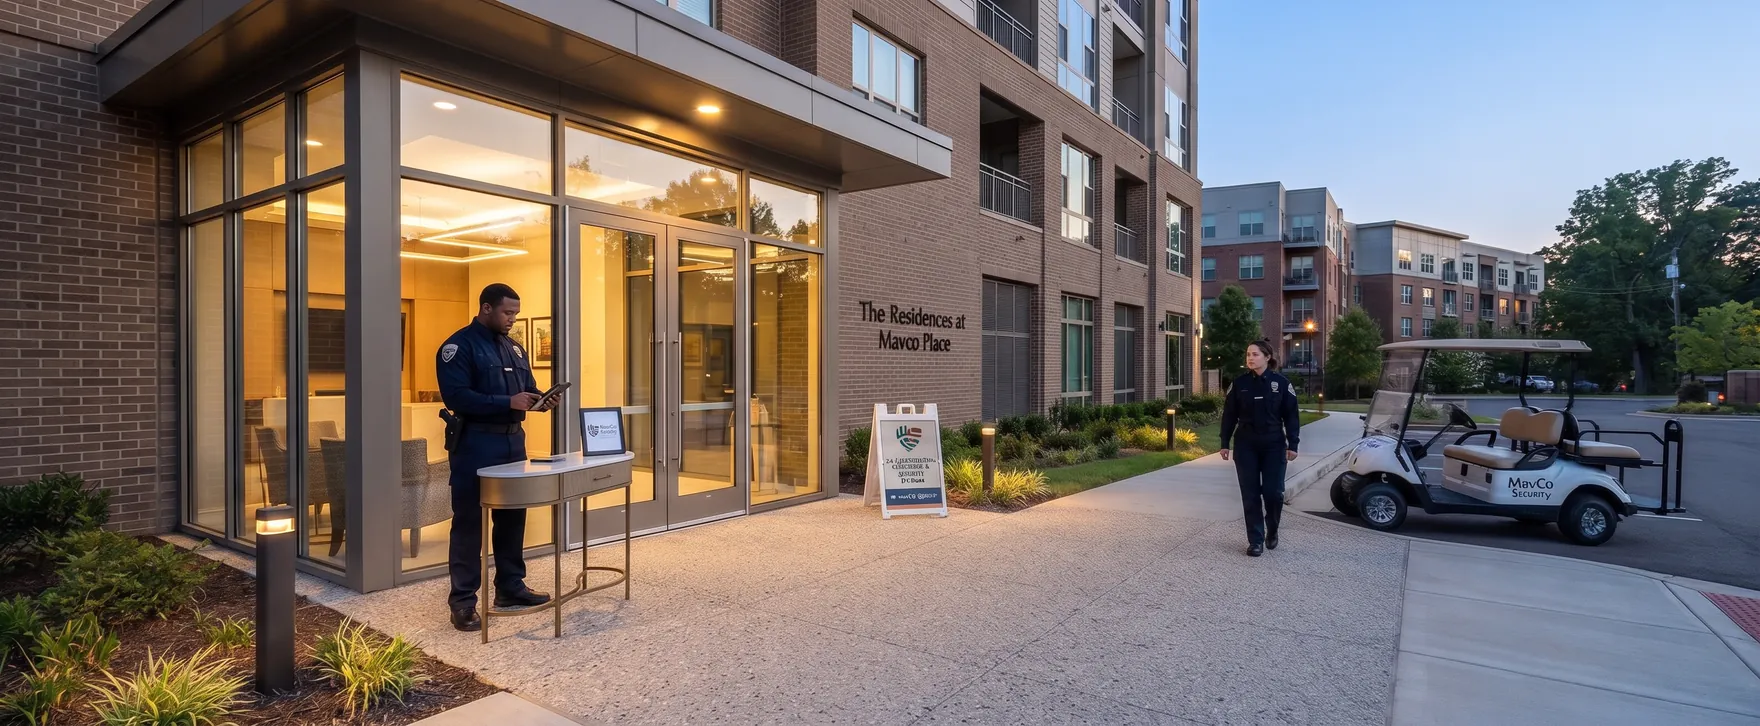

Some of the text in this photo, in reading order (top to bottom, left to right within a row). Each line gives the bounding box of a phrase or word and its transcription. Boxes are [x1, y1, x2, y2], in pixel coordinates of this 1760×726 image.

[859, 301, 966, 330] The Residences at
[879, 329, 951, 352] Mavco Place
[1508, 477, 1554, 490] MavCo
